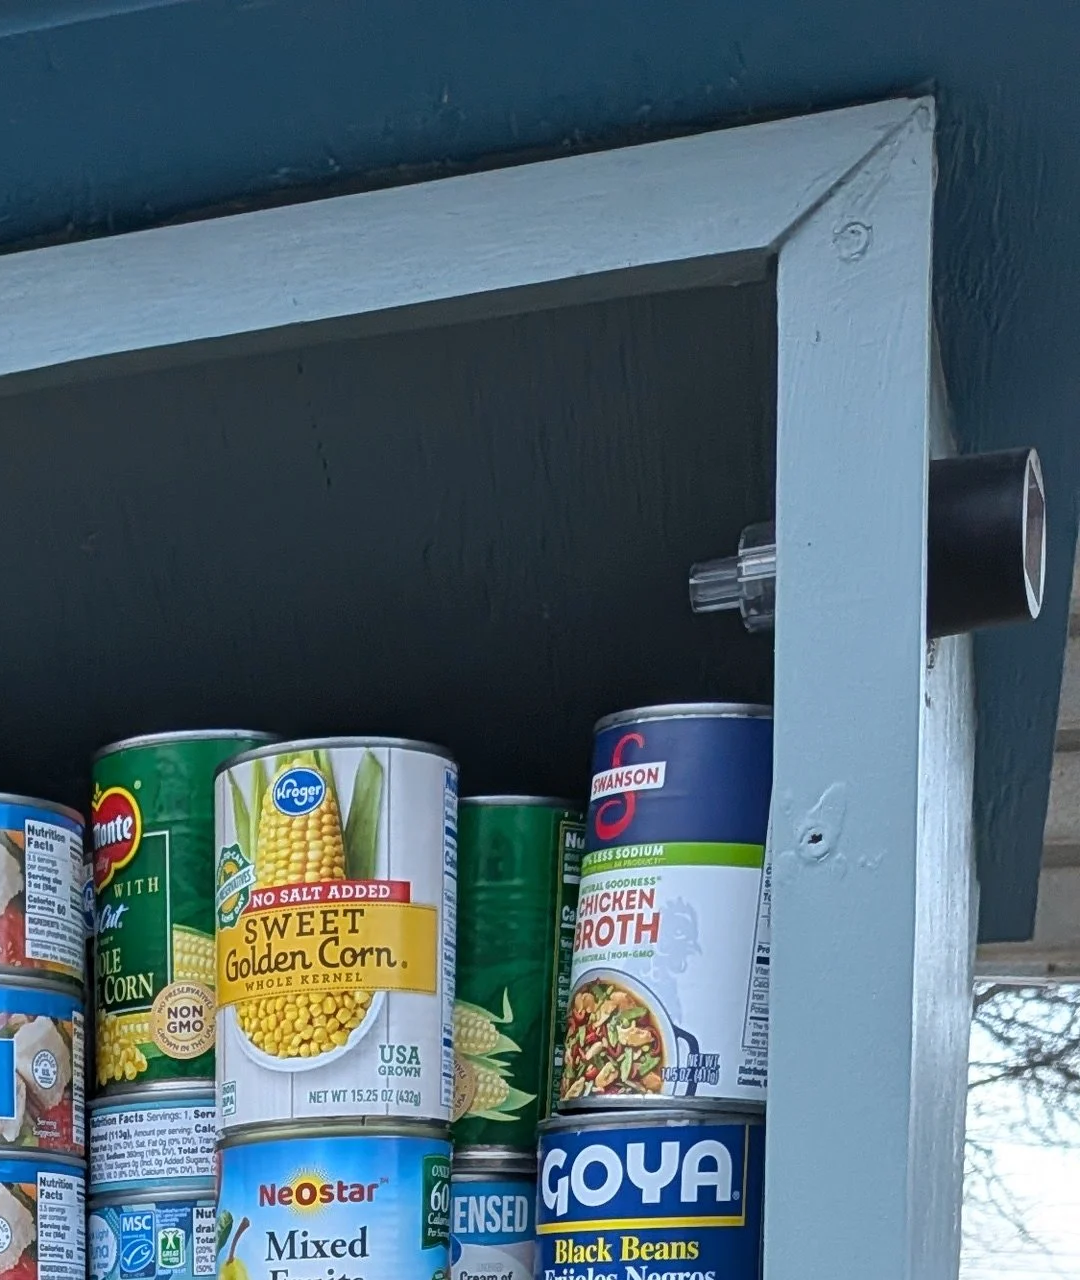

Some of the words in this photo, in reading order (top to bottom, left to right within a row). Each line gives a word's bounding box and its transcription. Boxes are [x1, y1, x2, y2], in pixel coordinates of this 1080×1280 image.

[276, 780, 322, 808] Kroger
[593, 767, 659, 795] SWANSON
[593, 850, 613, 863] LESS
[615, 845, 665, 859] SODIUM
[114, 877, 159, 898] WITH
[252, 890, 275, 908] NO
[279, 887, 321, 905] SALT
[327, 884, 391, 901] ADDED
[579, 888, 656, 919] CHICKEN
[244, 908, 365, 945] SWEET
[574, 911, 661, 953] BROTH
[226, 940, 313, 982] Golden
[318, 935, 398, 969] Corn
[104, 972, 155, 1006] CORN
[245, 975, 293, 991] WHOLE
[300, 972, 363, 987] KERNEL
[167, 1005, 204, 1020] NON
[167, 1019, 204, 1034] GMO
[379, 1043, 420, 1066] USA
[378, 1064, 422, 1079] GROWN
[309, 1091, 328, 1103] NET
[330, 1090, 348, 1102] WT
[351, 1089, 380, 1103] 15.25
[382, 1089, 394, 1102] OZ
[395, 1089, 422, 1105] (432g)
[541, 1139, 734, 1218] GOYA
[39, 1189, 64, 1201] Facts
[122, 1214, 152, 1231] MSC
[454, 1196, 528, 1233] ENSED
[264, 1225, 370, 1263] Mixed
[554, 1238, 612, 1265] Black
[619, 1235, 699, 1262] Beans
